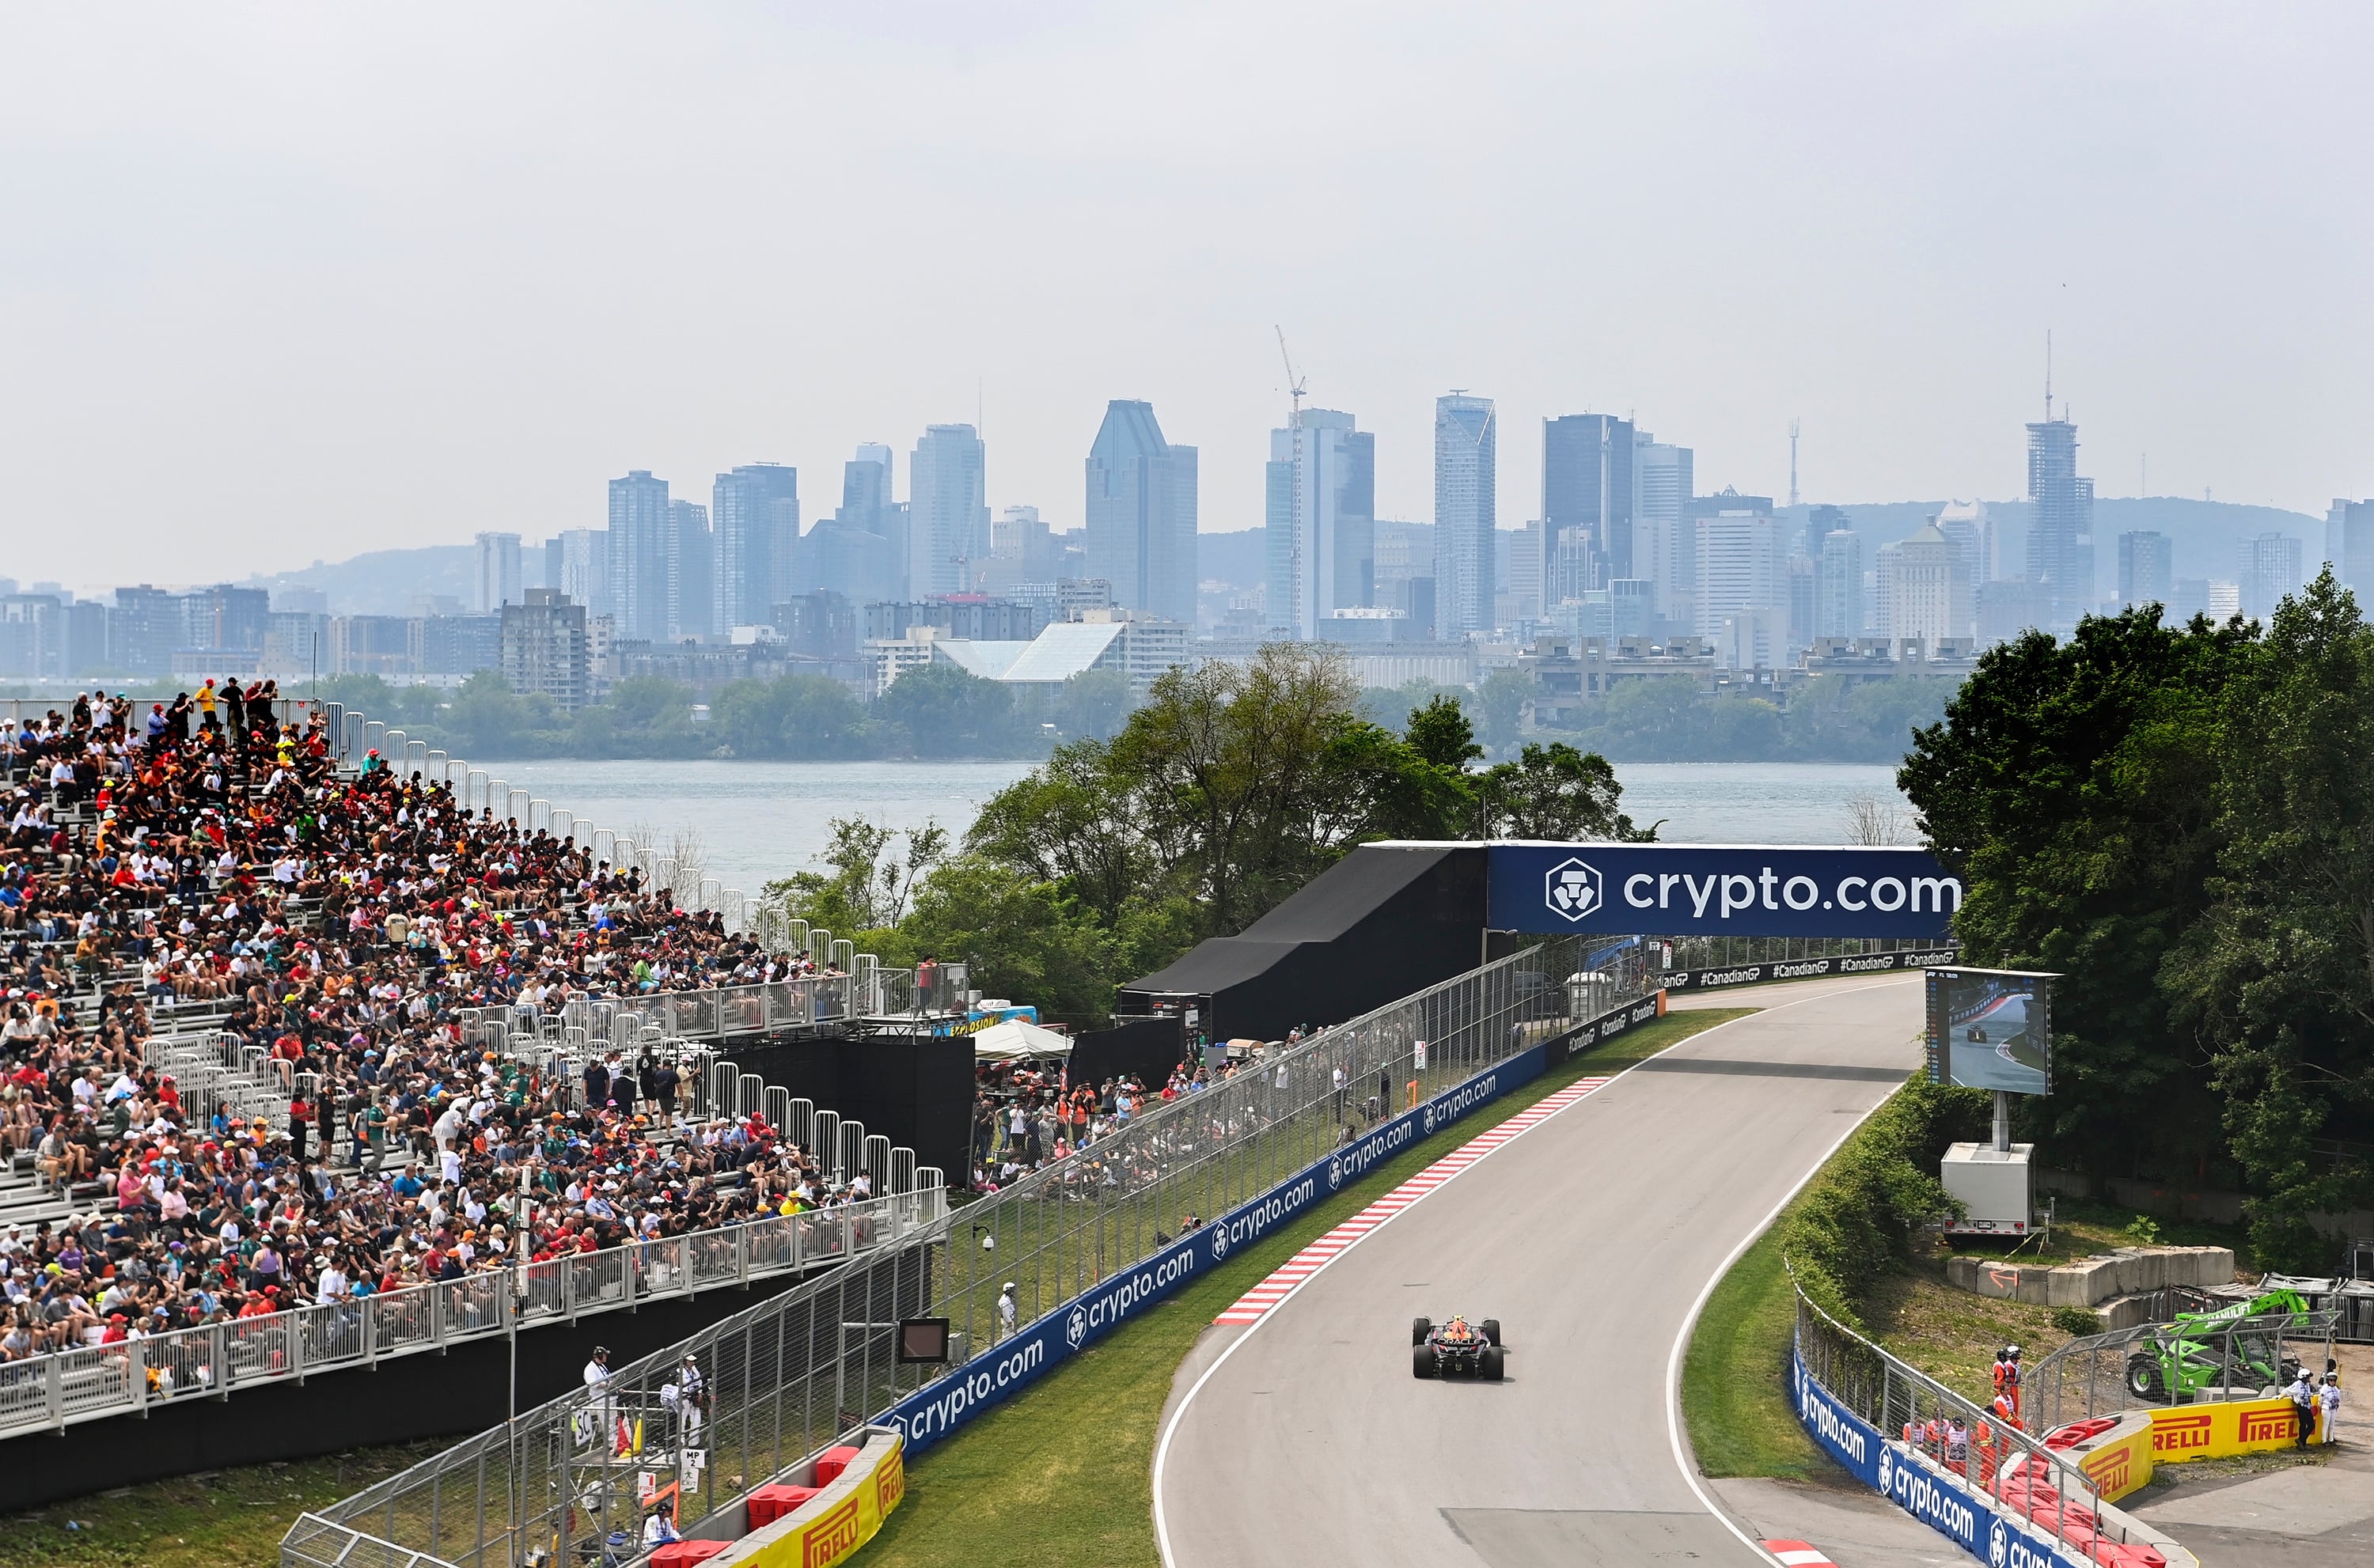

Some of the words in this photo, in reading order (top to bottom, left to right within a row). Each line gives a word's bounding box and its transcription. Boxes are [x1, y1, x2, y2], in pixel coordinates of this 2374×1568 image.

[1625, 867, 1962, 918] crypto.com
[1701, 968, 1760, 987] #CanadianGP
[1773, 960, 1829, 978] #CanadianGP
[1840, 956, 1894, 971] #CanadianGP
[1904, 952, 1954, 967] #CanadianGP
[1602, 1013, 1626, 1037] #CanadianGP
[1632, 1000, 1655, 1024] #CanadianGP
[1568, 1028, 1595, 1054] #CanadianGP
[1437, 1074, 1496, 1121] crypto.com
[1343, 1119, 1412, 1176] crypto.com
[1231, 1177, 1314, 1244] crypto.com
[1089, 1248, 1193, 1327] crypto.com
[911, 1339, 1043, 1440] crypto.com
[578, 1411, 590, 1440] SC
[1809, 1393, 1864, 1464] crypto.com
[2152, 1415, 2212, 1451] PRELLI
[2238, 1405, 2319, 1443] PIREL
[2085, 1446, 2130, 1498] PRELLI
[1895, 1465, 1974, 1542] crypto.com
[802, 1497, 859, 1568] PIRELLI
